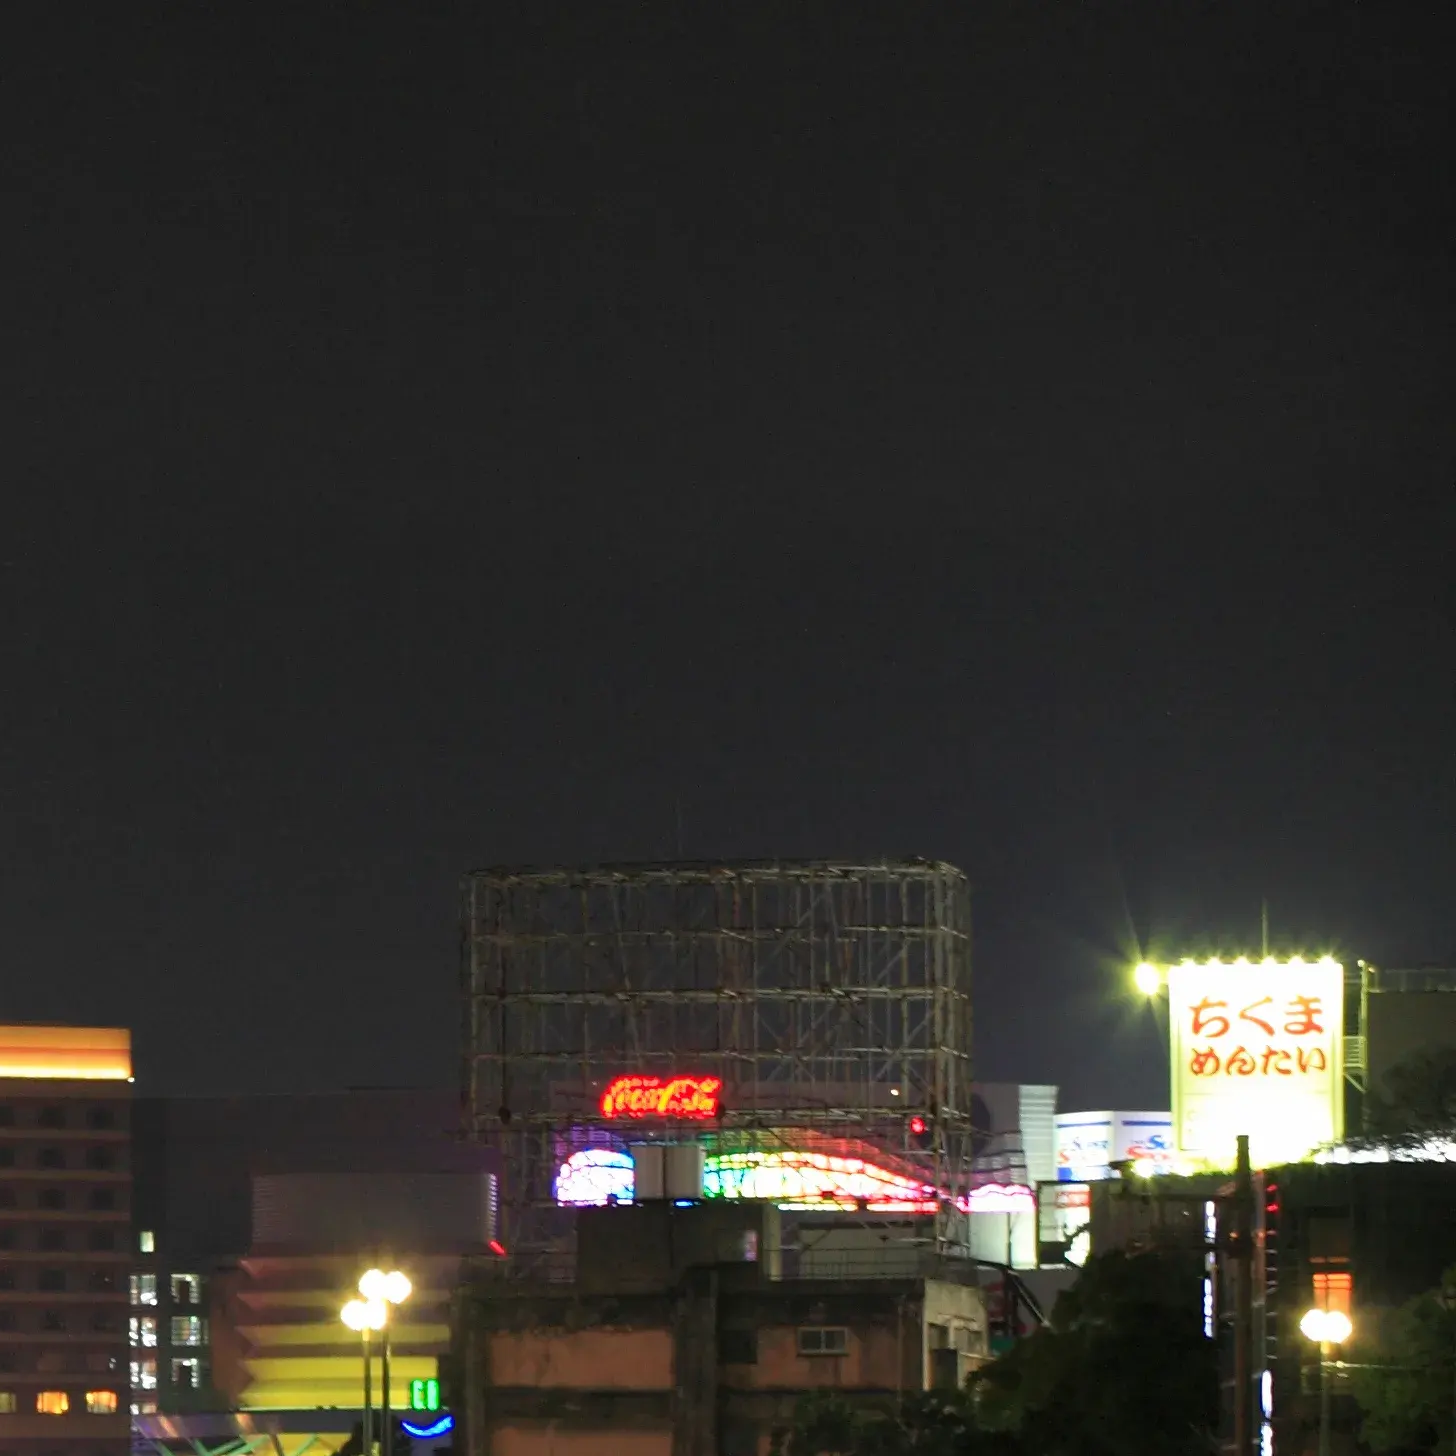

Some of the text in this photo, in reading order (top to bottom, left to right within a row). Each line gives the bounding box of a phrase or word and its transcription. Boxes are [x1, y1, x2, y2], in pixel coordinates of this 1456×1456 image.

[1189, 995, 1324, 1039] ちくま
[1190, 1045, 1326, 1077] めんたい
